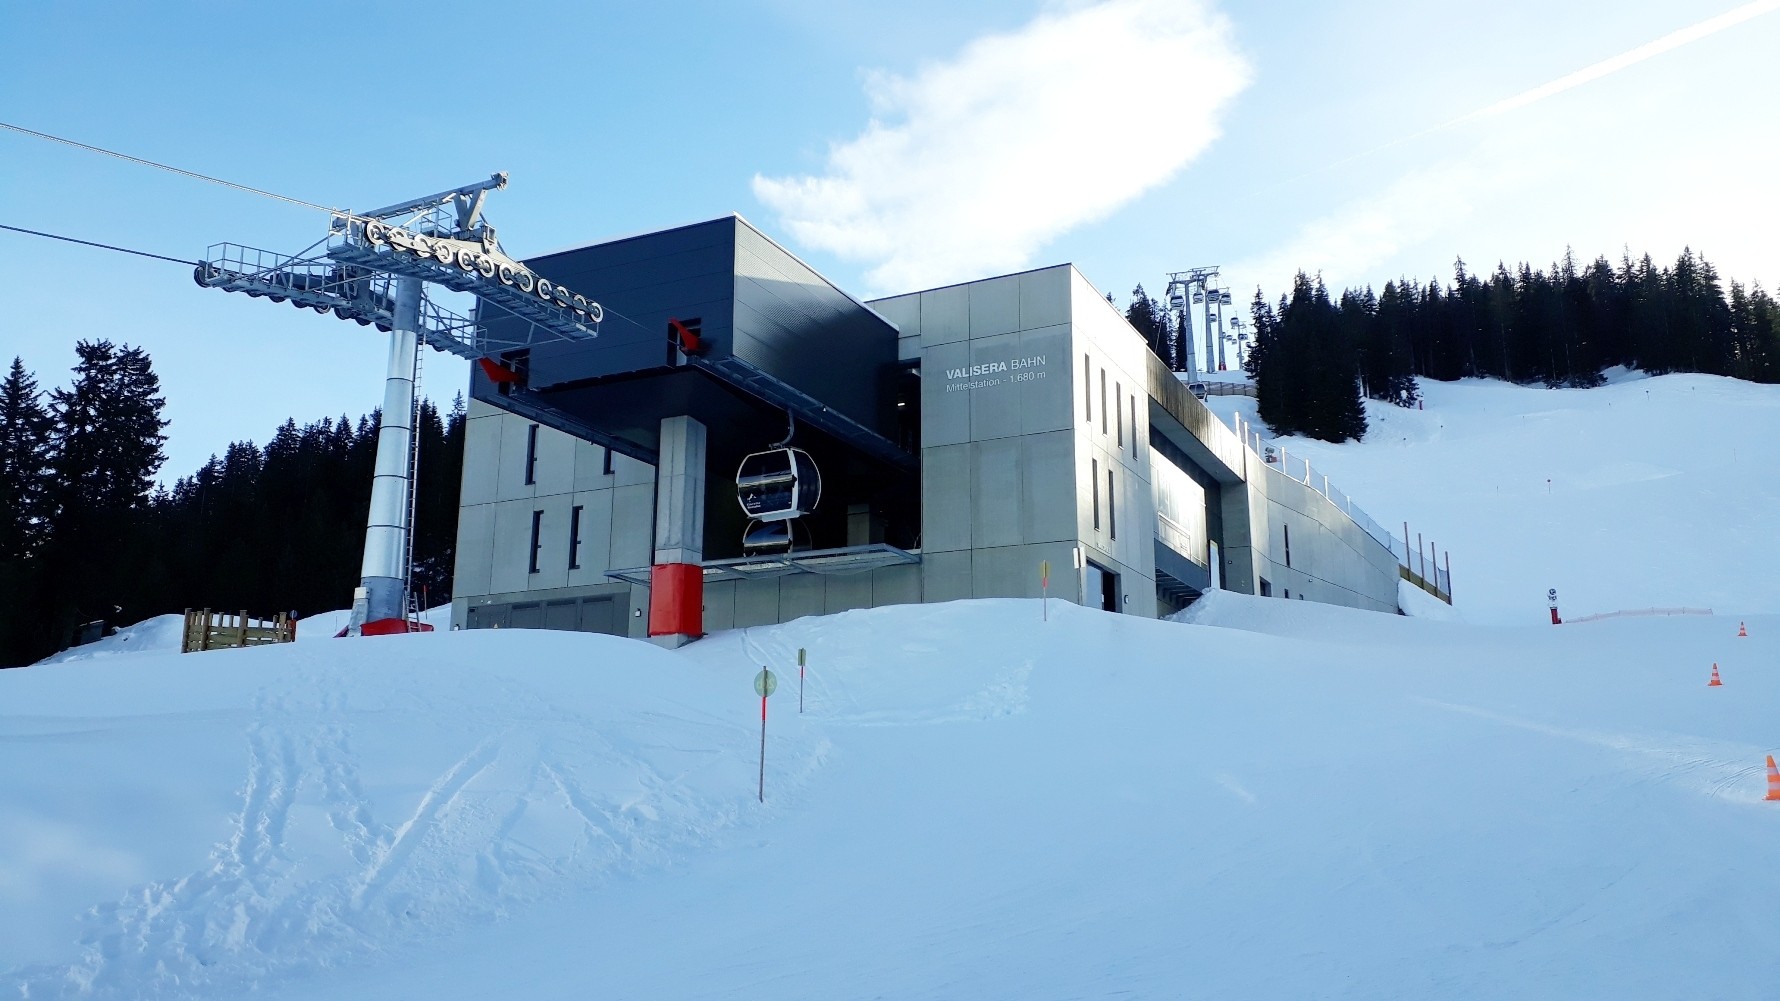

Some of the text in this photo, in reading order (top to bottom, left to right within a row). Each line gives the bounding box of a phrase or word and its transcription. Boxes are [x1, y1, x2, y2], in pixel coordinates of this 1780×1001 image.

[946, 355, 1046, 380] VALISERA BAHN
[946, 378, 1000, 393] Mittelstation
[1010, 372, 1035, 383] 1.680
[1037, 371, 1046, 379] m
